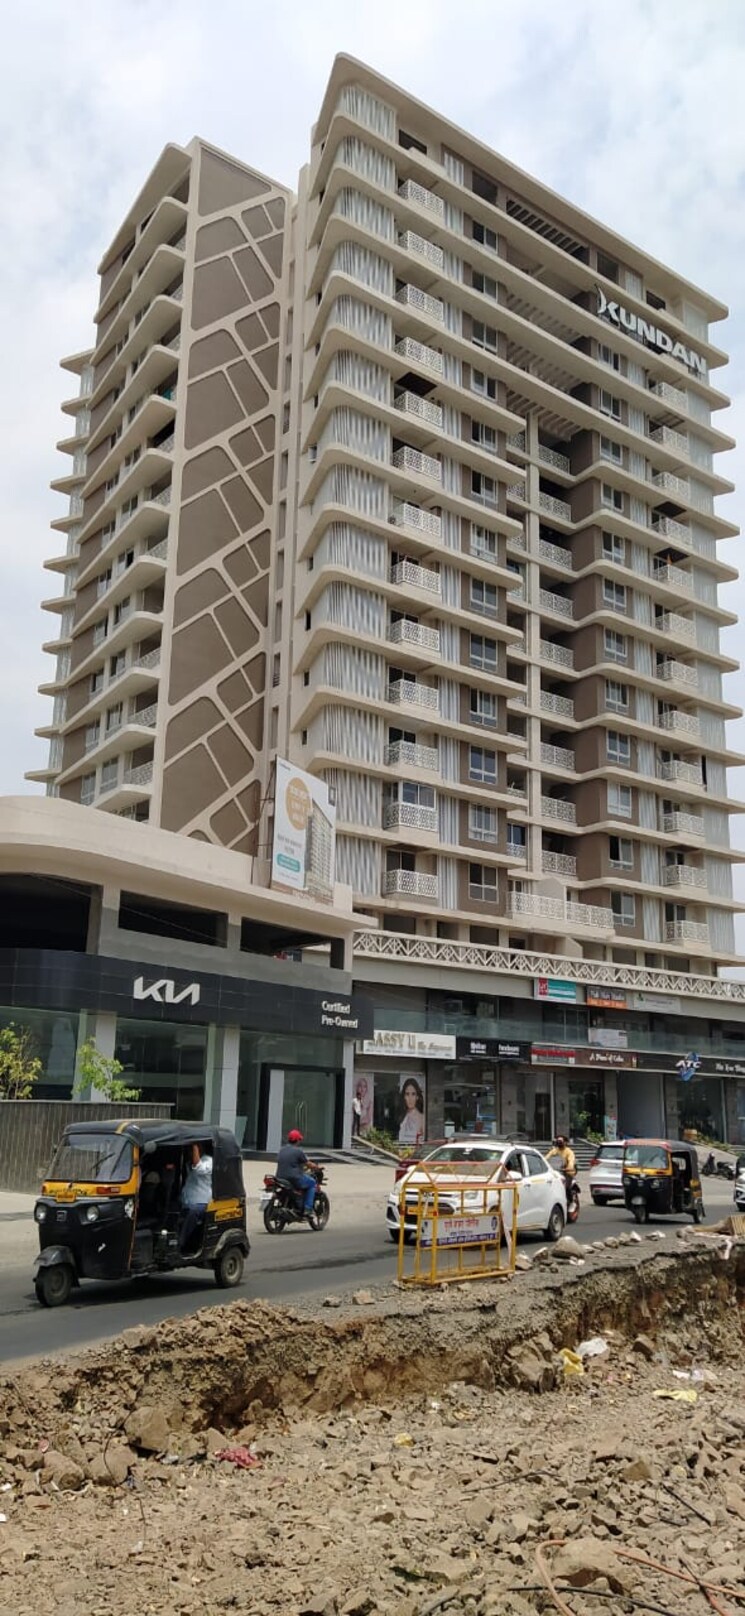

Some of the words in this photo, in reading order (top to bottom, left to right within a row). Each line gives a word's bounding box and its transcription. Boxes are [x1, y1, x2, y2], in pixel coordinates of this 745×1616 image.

[598, 287, 707, 374] KUNDAN
[322, 1000, 350, 1014] Certified
[321, 1014, 358, 1029] Pre-Owned
[675, 1060, 702, 1069] ATC
